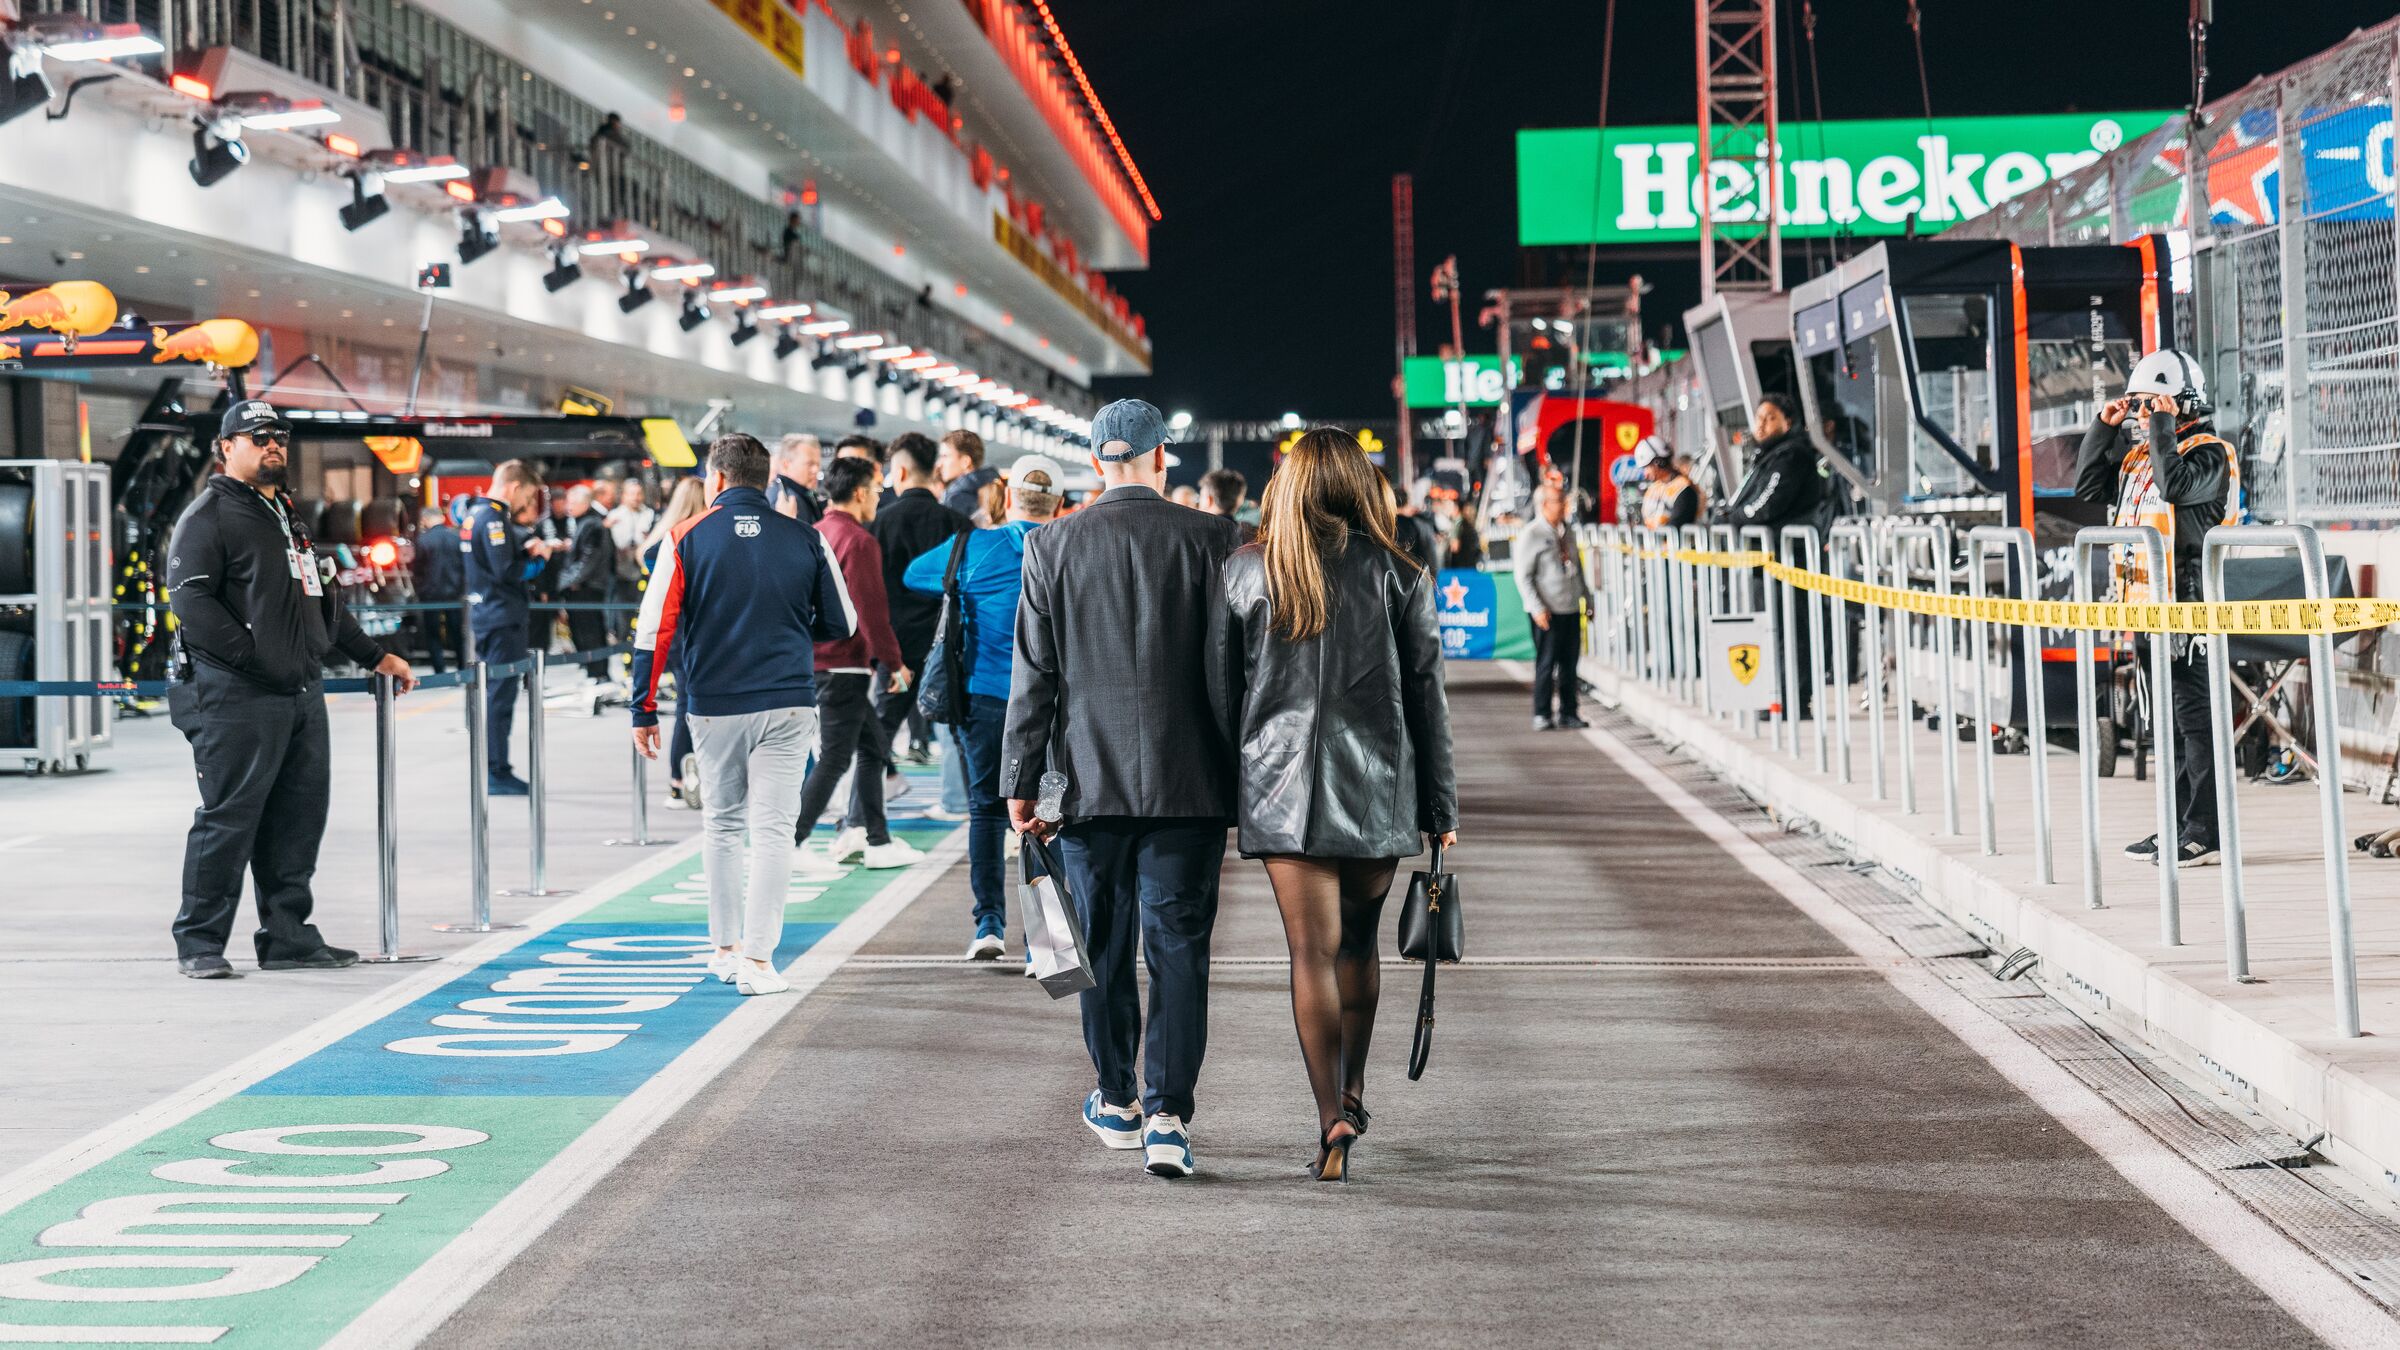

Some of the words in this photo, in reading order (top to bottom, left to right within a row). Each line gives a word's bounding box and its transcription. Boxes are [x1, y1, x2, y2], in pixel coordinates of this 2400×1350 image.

[423, 422, 493, 437] Einhell
[736, 522, 760, 535] FIA
[384, 935, 716, 1057] aramco
